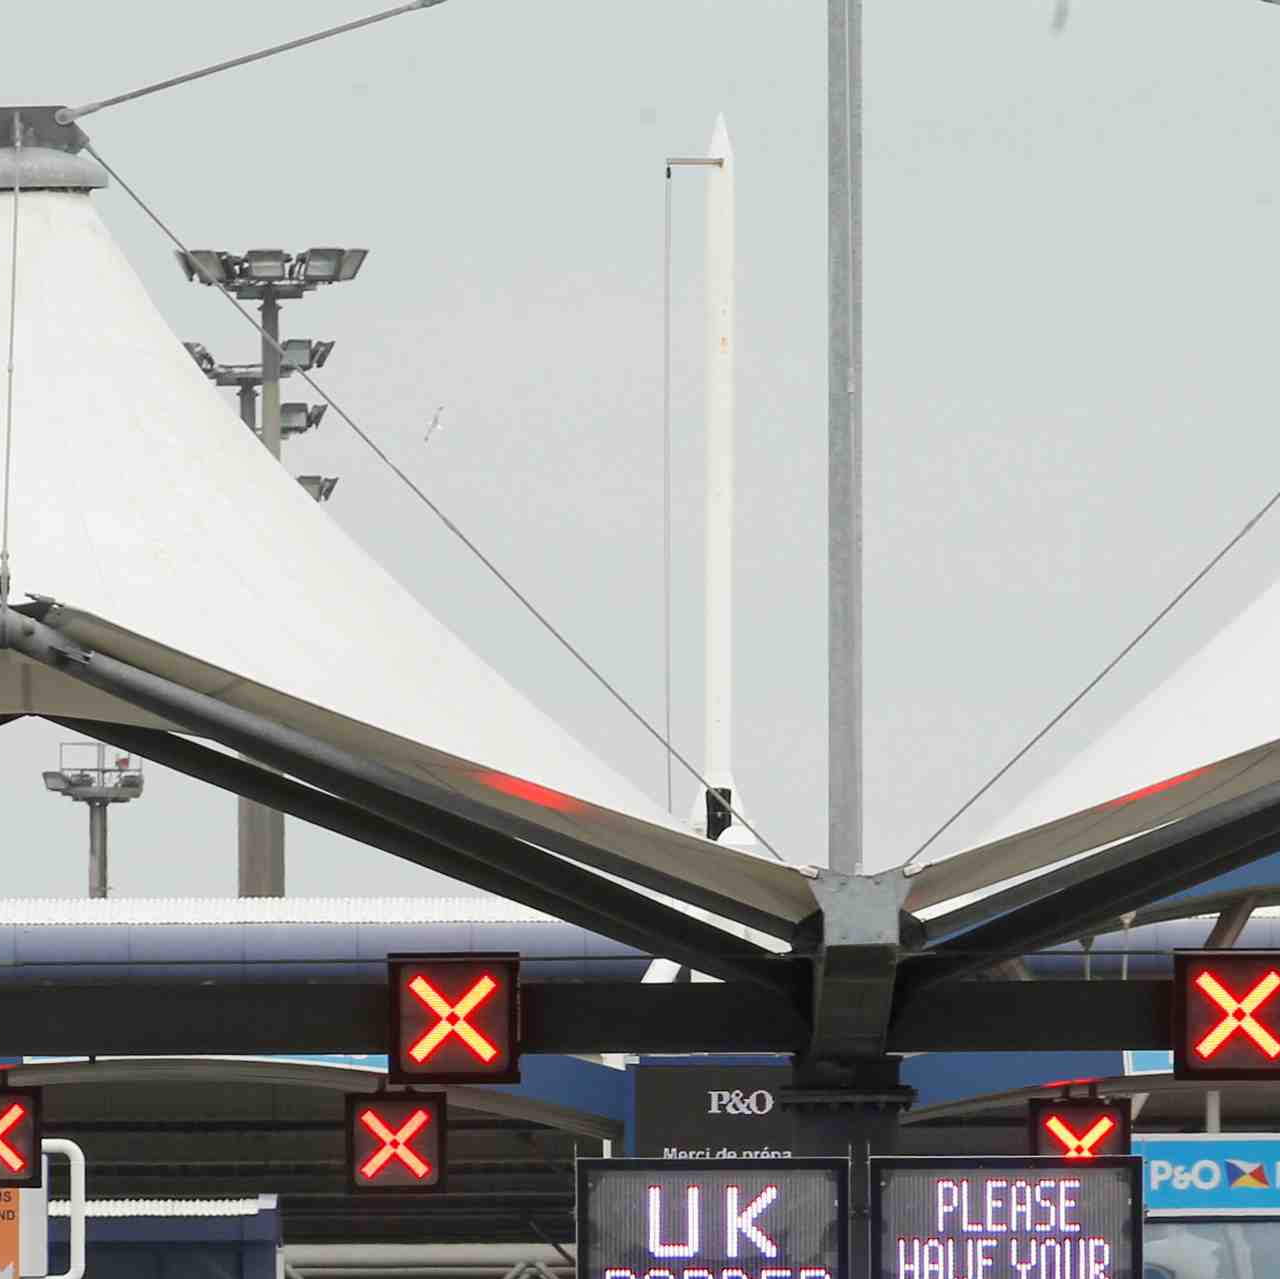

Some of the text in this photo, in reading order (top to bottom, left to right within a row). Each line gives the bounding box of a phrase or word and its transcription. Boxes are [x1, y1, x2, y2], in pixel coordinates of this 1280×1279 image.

[707, 1089, 774, 1115] P&O
[1150, 1160, 1221, 1189] P&O
[646, 1185, 780, 1260] UK
[934, 1178, 1082, 1232] PLEASE
